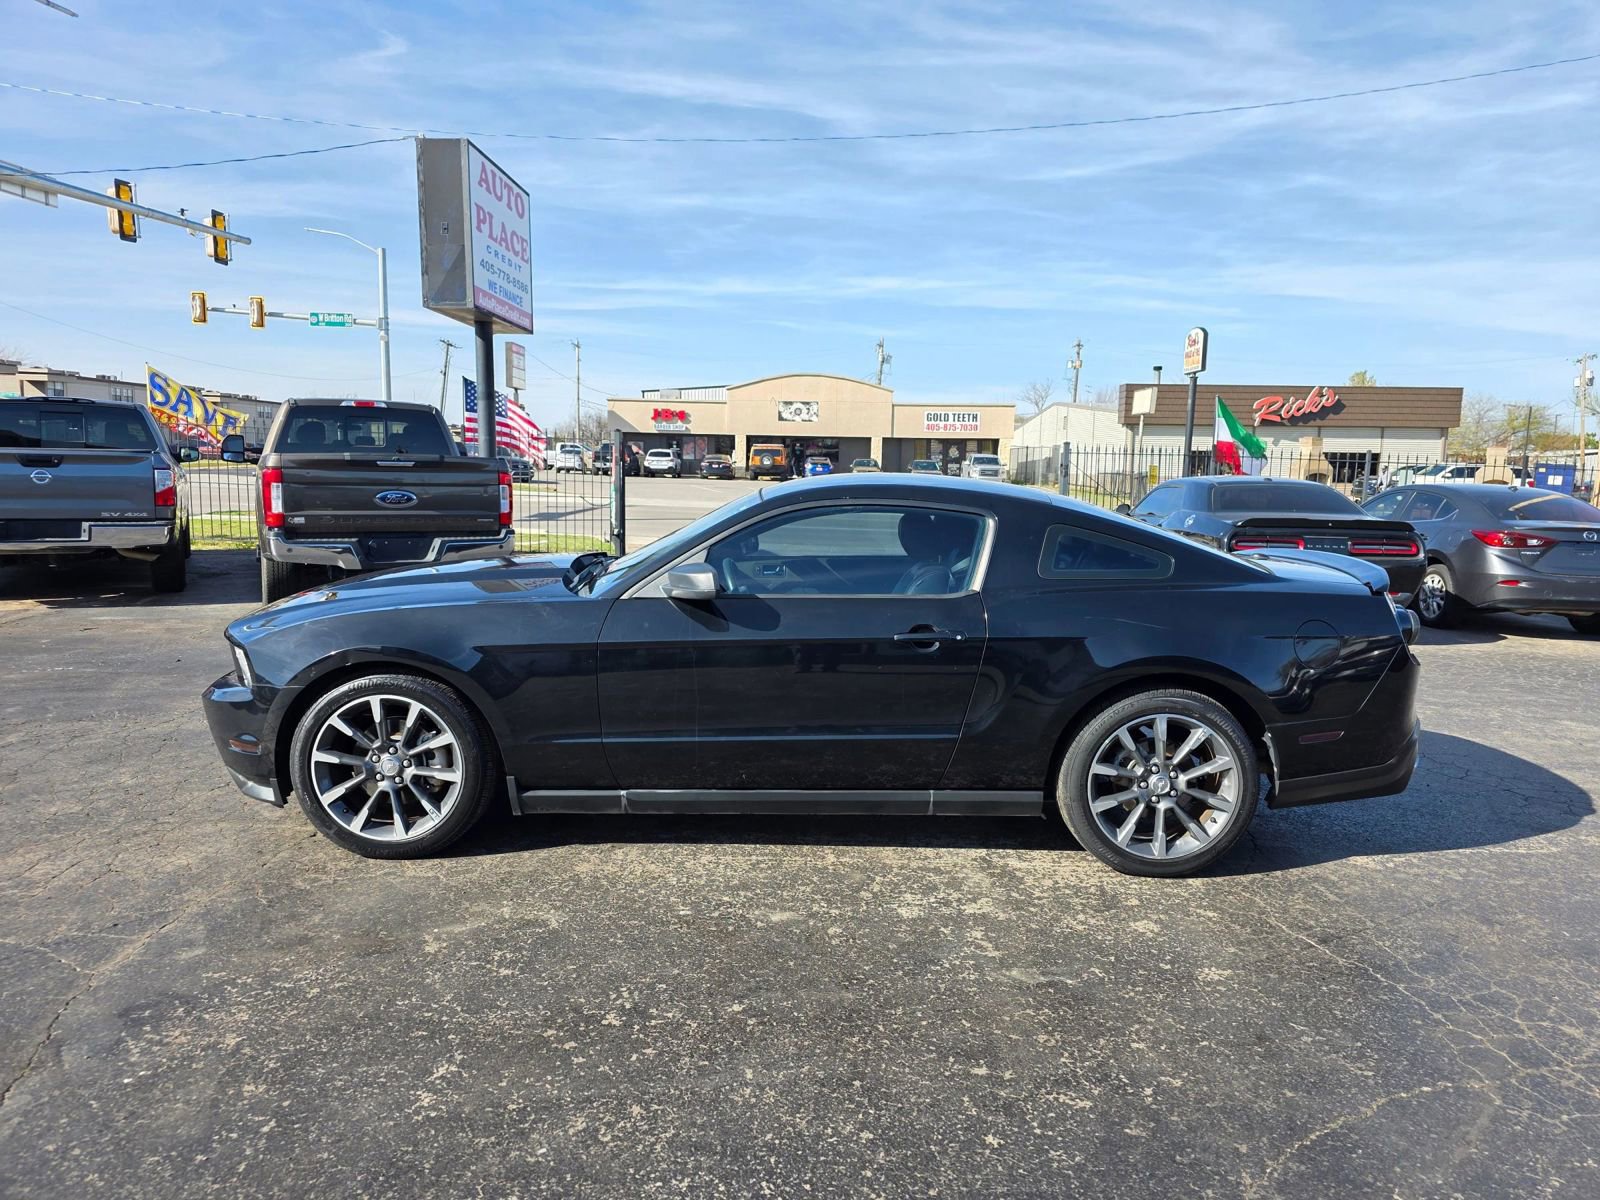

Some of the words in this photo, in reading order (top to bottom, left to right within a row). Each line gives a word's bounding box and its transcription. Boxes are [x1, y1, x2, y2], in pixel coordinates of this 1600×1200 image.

[478, 161, 525, 219] AUTO
[475, 202, 529, 264] PLACE
[480, 258, 529, 294] 405-778-8586
[487, 245, 521, 273] CREDIT
[488, 279, 498, 294] WE
[499, 285, 524, 307] FINANCE
[149, 372, 241, 437] SAVE
[926, 412, 950, 422] GOLD
[952, 412, 978, 423] TEETH
[1253, 386, 1339, 426] Rick's
